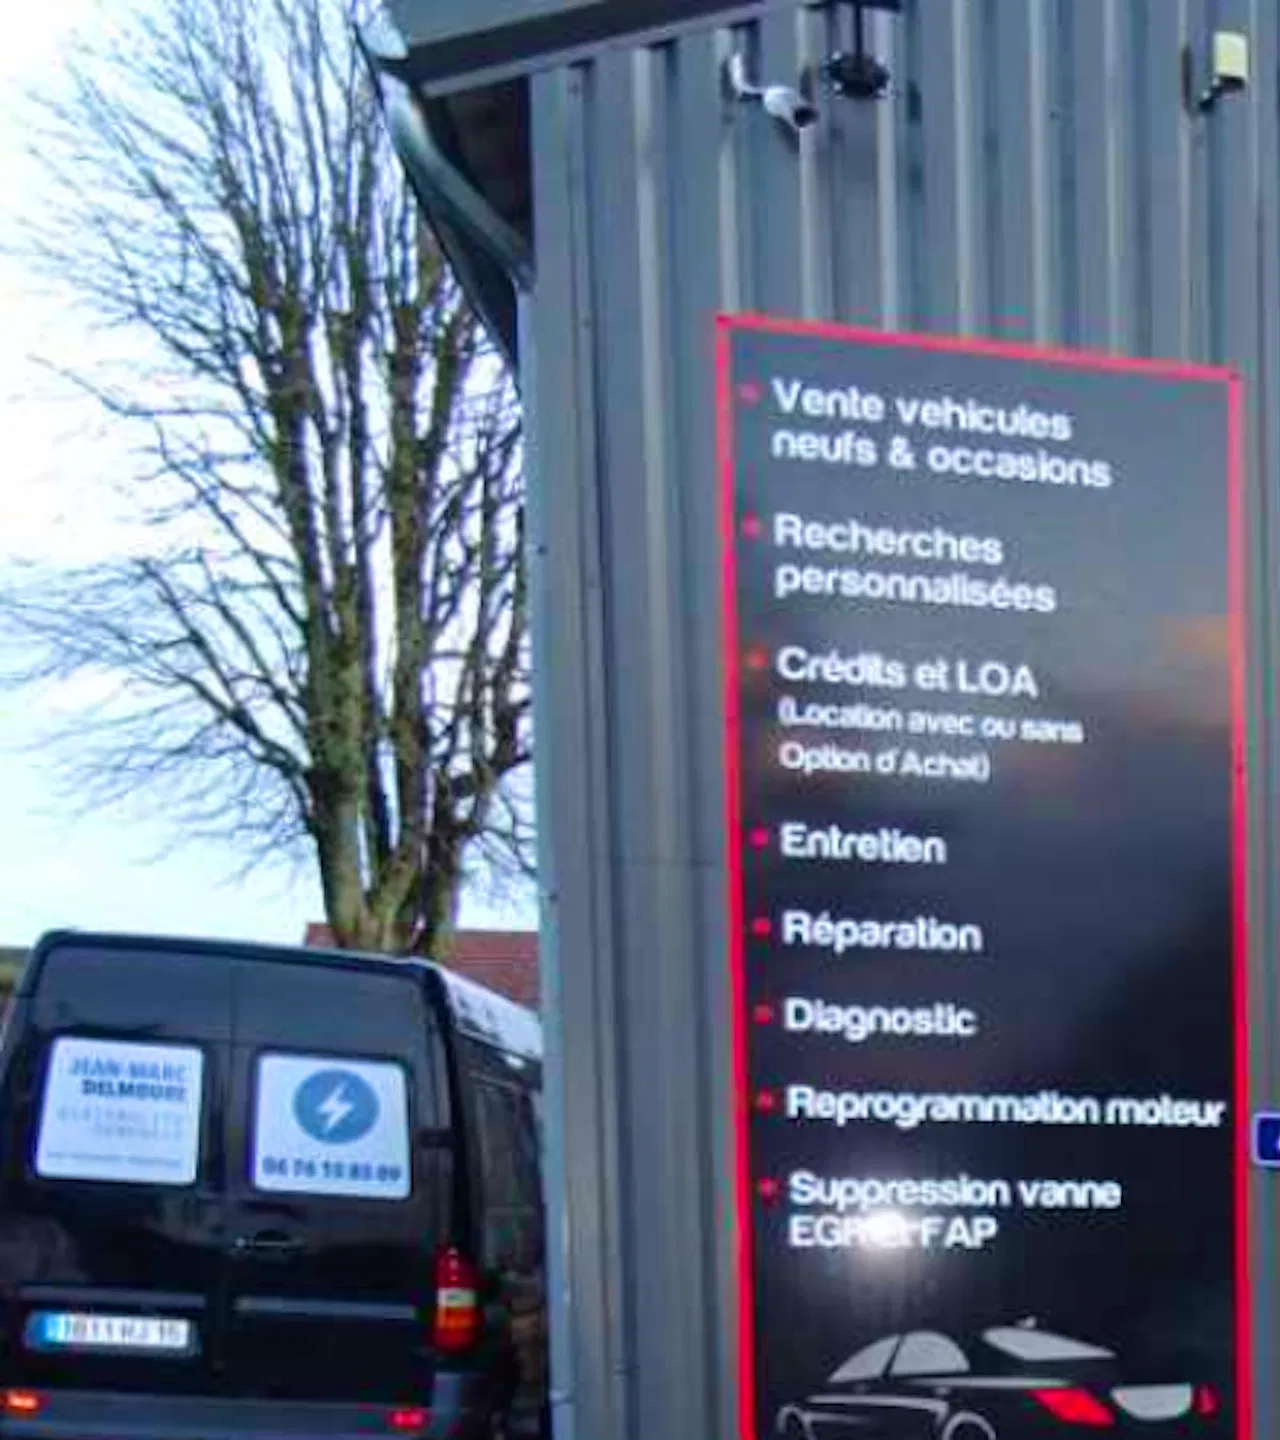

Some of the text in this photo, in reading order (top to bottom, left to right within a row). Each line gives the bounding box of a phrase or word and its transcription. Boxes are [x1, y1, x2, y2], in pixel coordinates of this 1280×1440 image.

[771, 376, 1073, 441] Vente vehicules
[771, 429, 1113, 488] neufs & occasions
[773, 511, 1003, 565] Recherches
[774, 563, 1057, 613] personnalisées
[776, 646, 1039, 699] Crédits et LOA
[907, 709, 975, 735] avec
[981, 714, 1017, 740] ou
[1019, 719, 1085, 744] sans
[778, 741, 871, 776] Option
[779, 821, 947, 864] Entretien
[781, 909, 984, 956] Réparation
[784, 997, 978, 1043] Diagnostic
[786, 1085, 1226, 1131] Reprogrammation moteur
[788, 1169, 1123, 1212] Suppression vanne
[921, 1215, 999, 1249] FAP
